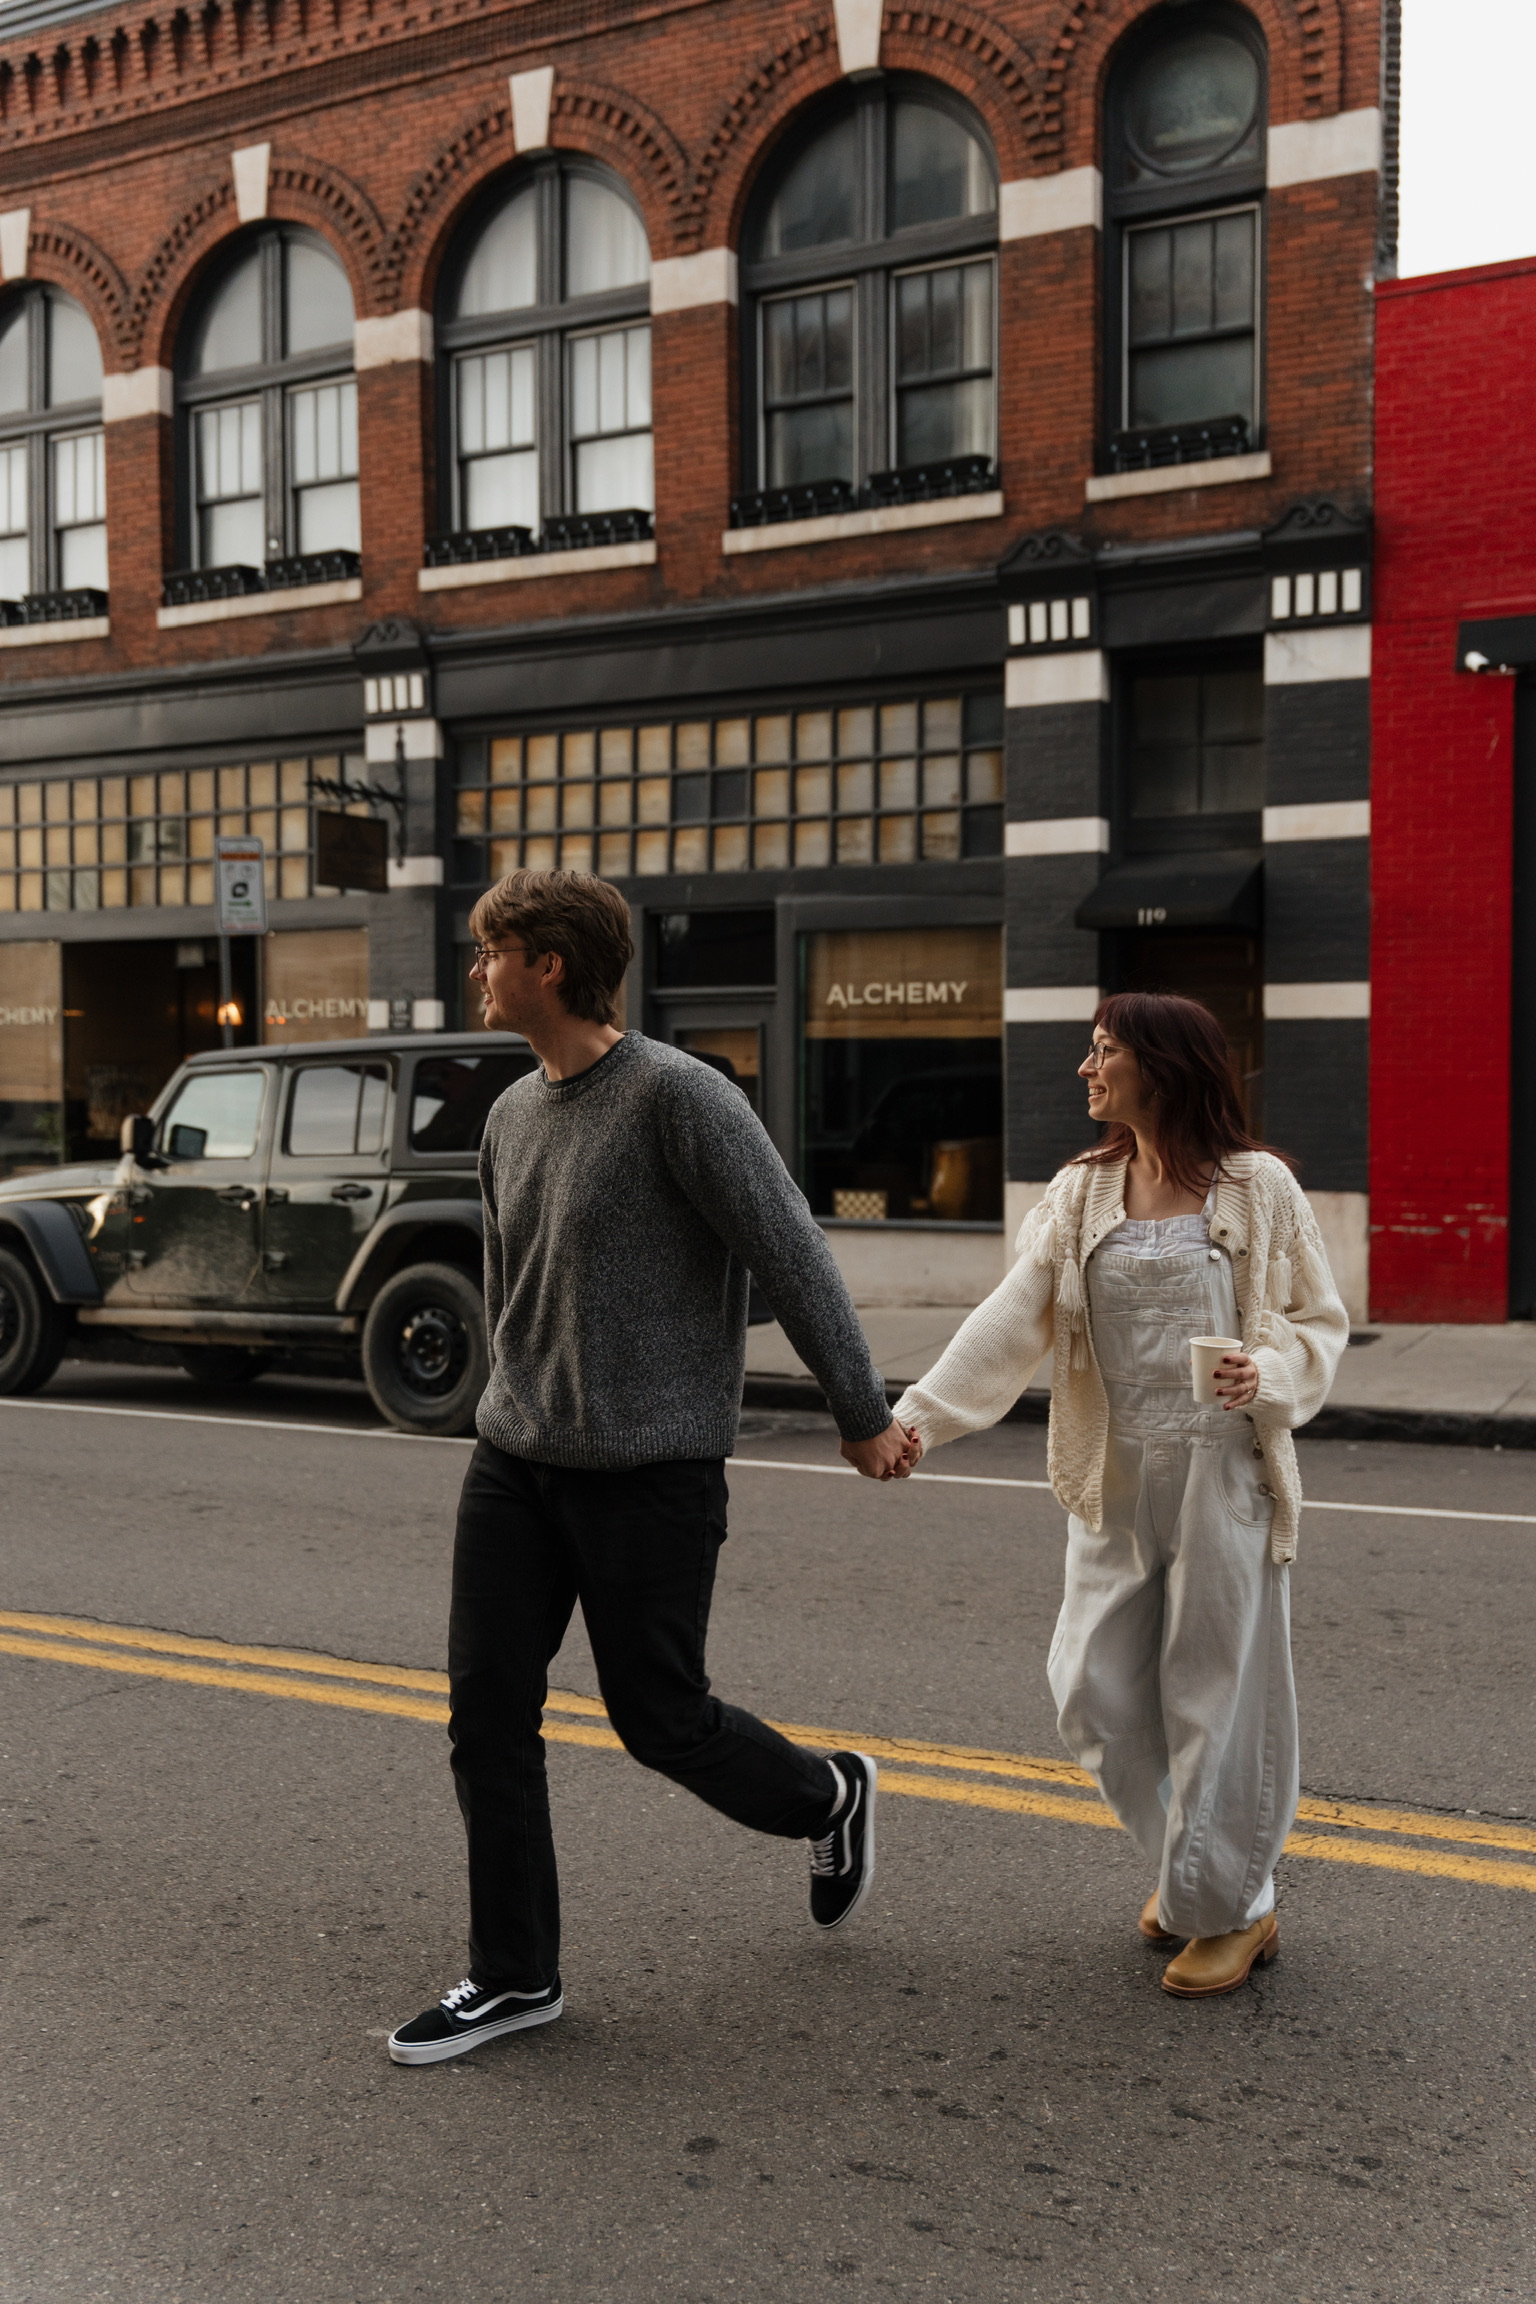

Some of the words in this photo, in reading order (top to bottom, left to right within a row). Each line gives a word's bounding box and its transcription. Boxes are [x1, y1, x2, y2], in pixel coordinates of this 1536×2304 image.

[1138, 907, 1167, 926] 119
[826, 981, 967, 1008] ALCHEMY
[264, 998, 368, 1018] ALCHEMY
